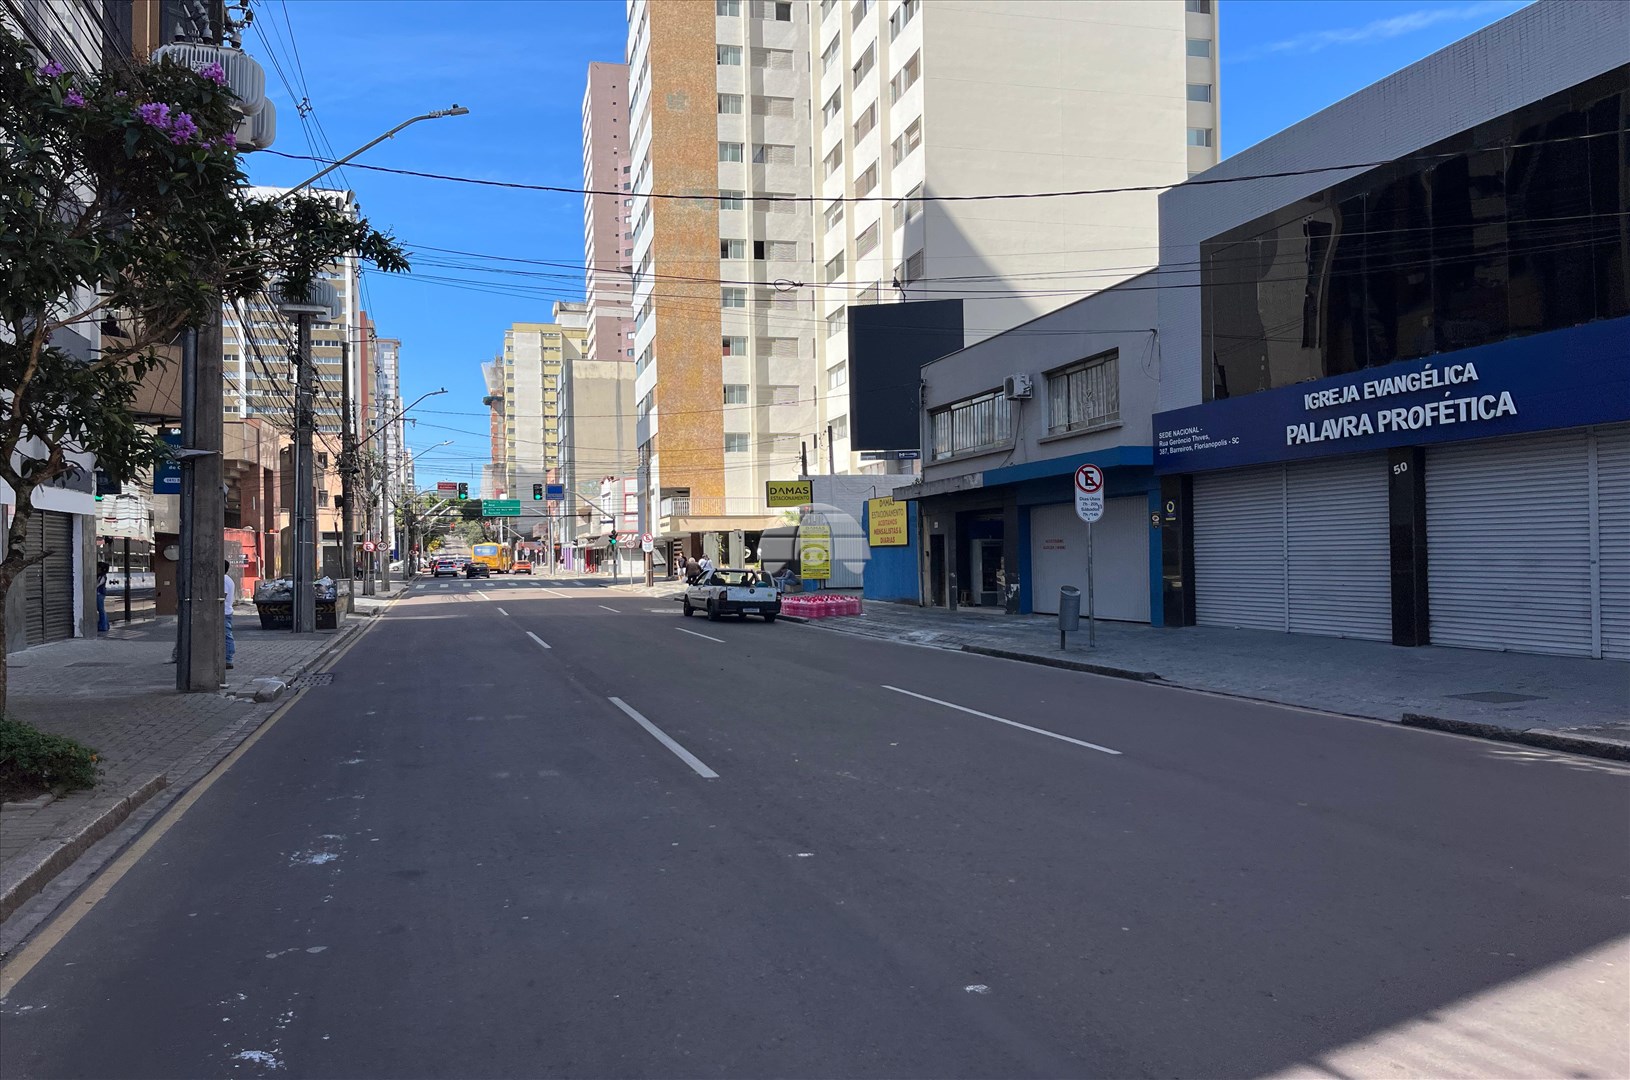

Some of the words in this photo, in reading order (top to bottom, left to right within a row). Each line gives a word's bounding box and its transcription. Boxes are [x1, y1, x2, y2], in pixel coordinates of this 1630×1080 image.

[1303, 384, 1361, 411] IGREJA
[1363, 362, 1479, 400] EVANGÉLICA
[1286, 413, 1375, 446] PALAVRA
[1377, 391, 1518, 434] PROFÉTICA
[1158, 430, 1172, 439] SEDE
[1172, 426, 1200, 437] NACIONAL
[1169, 445, 1194, 454] Barreiros,
[1231, 437, 1240, 445] SC
[1393, 462, 1408, 475] 50
[770, 486, 809, 495] DAMAS
[871, 509, 904, 519] ESTACIONAMENTO
